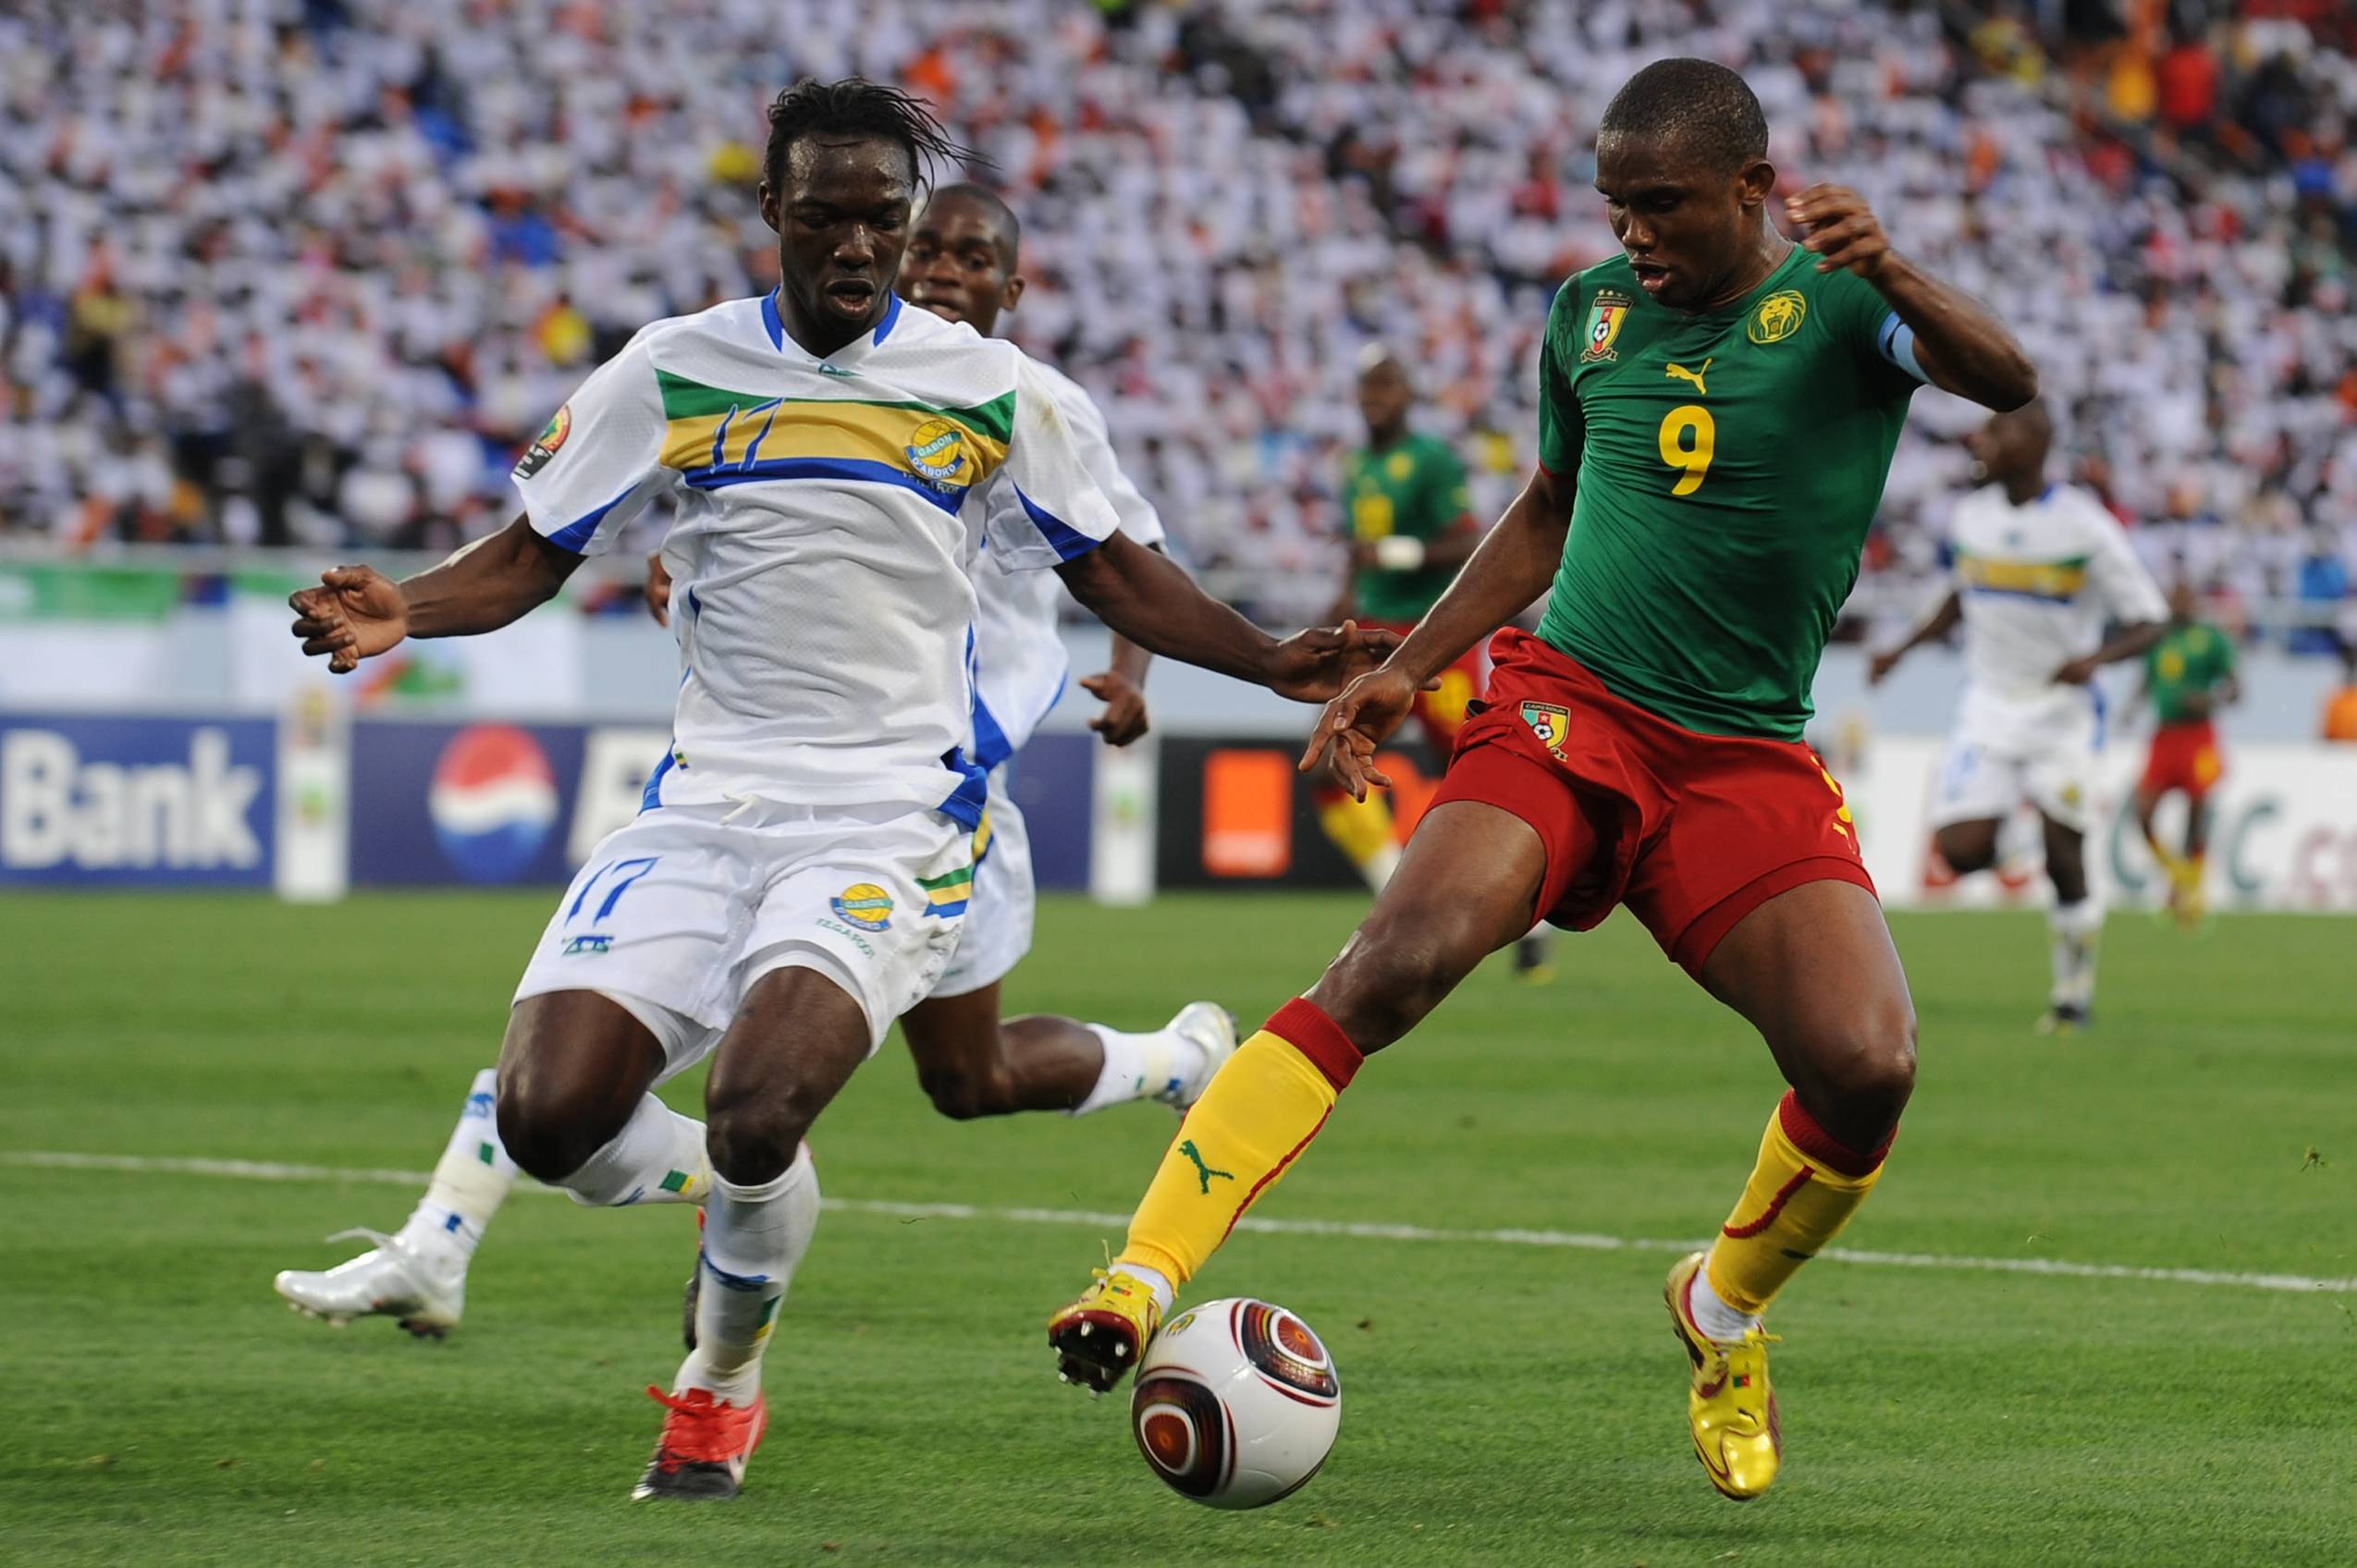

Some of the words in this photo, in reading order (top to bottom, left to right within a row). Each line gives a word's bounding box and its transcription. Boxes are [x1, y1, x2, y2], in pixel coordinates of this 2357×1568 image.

[709, 396, 785, 475] 17
[916, 433, 953, 458] GABON
[1658, 404, 1715, 496] 9
[2, 727, 263, 871] Bank
[563, 855, 663, 929] 17
